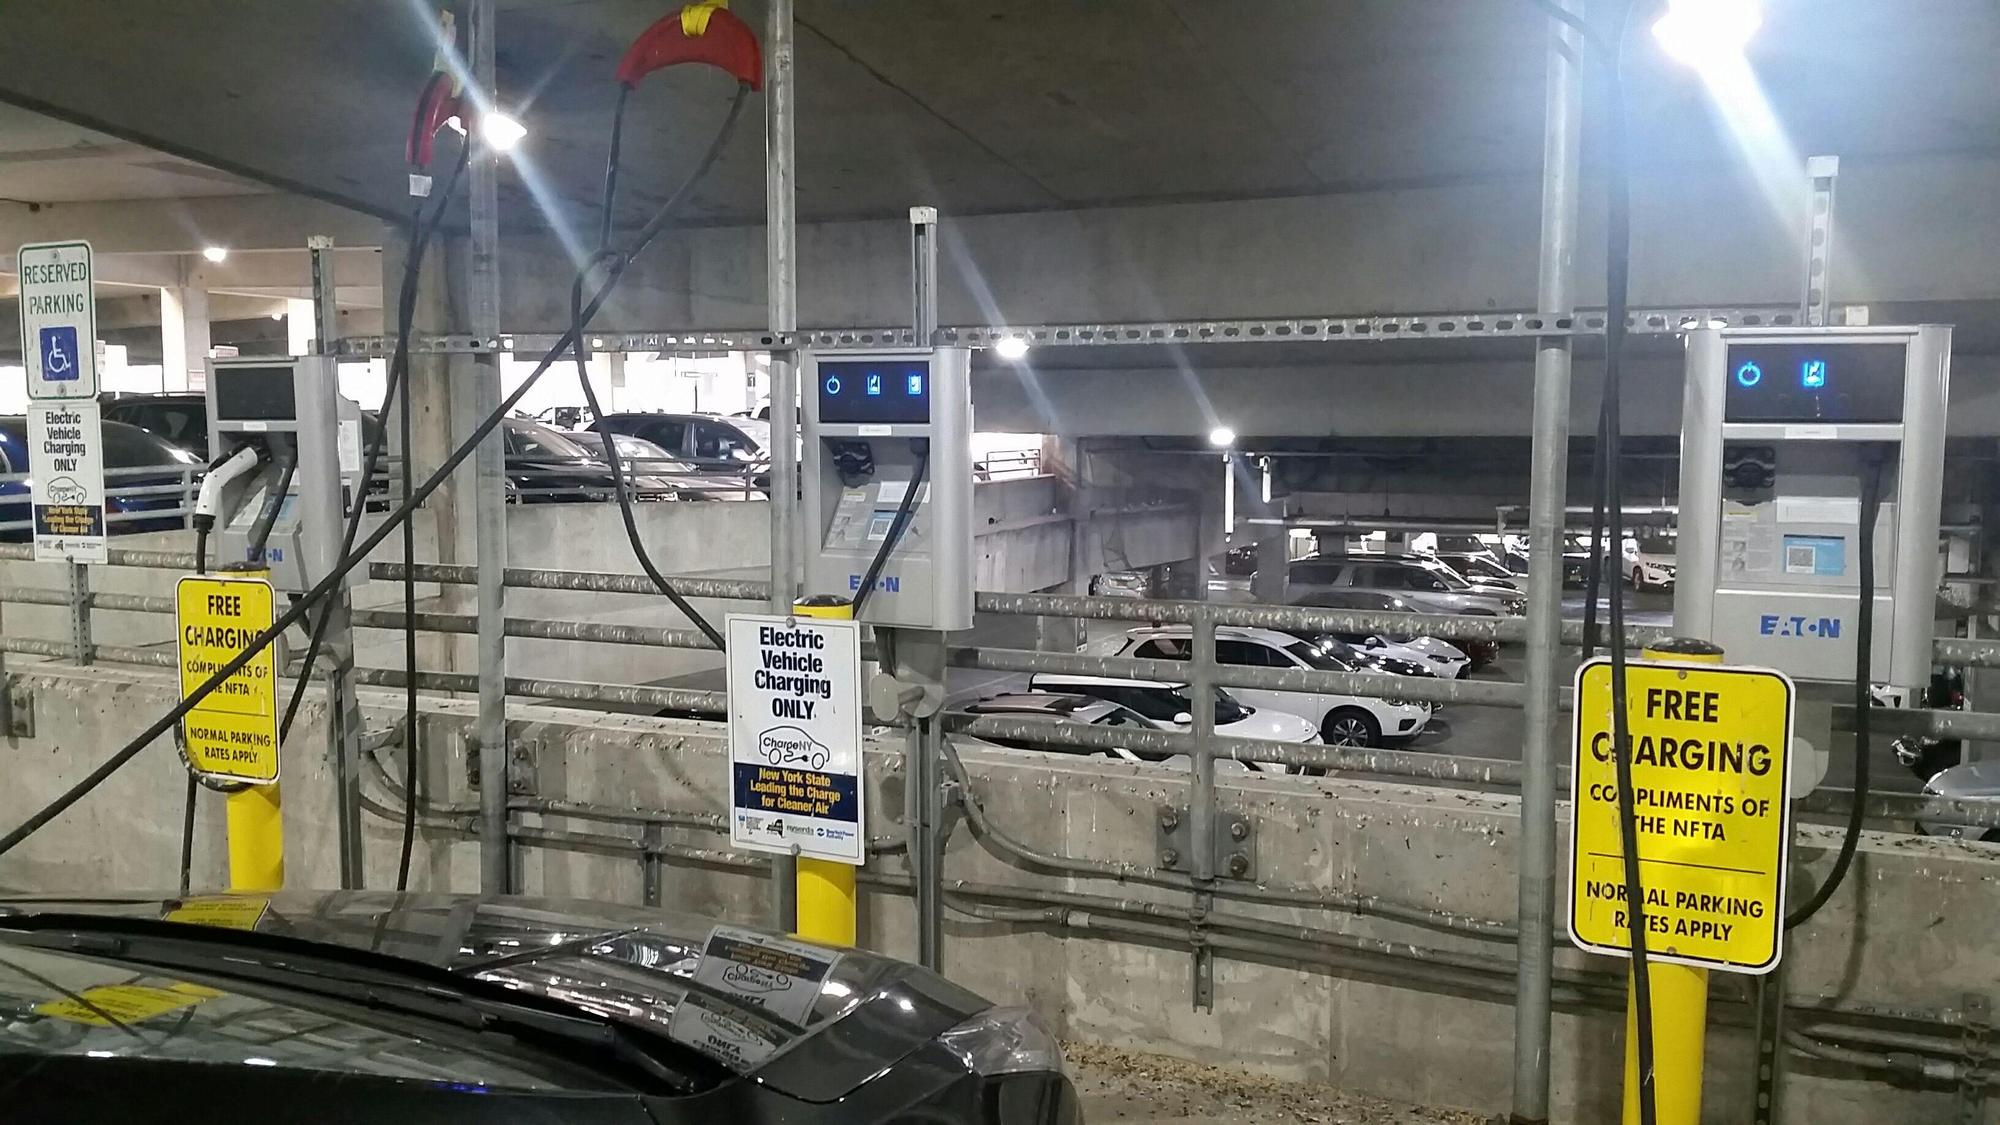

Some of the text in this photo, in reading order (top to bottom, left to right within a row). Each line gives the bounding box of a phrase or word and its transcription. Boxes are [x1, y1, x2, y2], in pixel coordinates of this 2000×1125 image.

[24, 262, 87, 284] RESERVED
[29, 293, 84, 315] PARKING
[45, 411, 81, 424] Electric
[46, 426, 81, 440] Vehicle
[43, 441, 86, 456] Charging
[54, 459, 77, 472] ONLY
[207, 595, 241, 617] FREE
[759, 626, 824, 650] Electric
[255, 666, 268, 678] OF
[761, 650, 823, 673] Vehicle
[225, 682, 249, 696] NFTA
[754, 669, 831, 699] Charging
[772, 698, 815, 720] ONLY
[1646, 688, 1719, 723] FREE
[190, 727, 271, 747] NORMAL PARKING
[763, 737, 813, 751] ChargeNY
[204, 747, 258, 764] RATES APPLY
[759, 767, 831, 787] New York State
[750, 780, 841, 803] Leading the Charge
[1590, 783, 1769, 818] COPLIMENTS OF
[761, 795, 829, 814] for Cleaner Air
[1673, 821, 1726, 841] NFTA
[1586, 880, 1764, 918] NORAL PARKING
[1615, 911, 1733, 941] RTES APPLY
